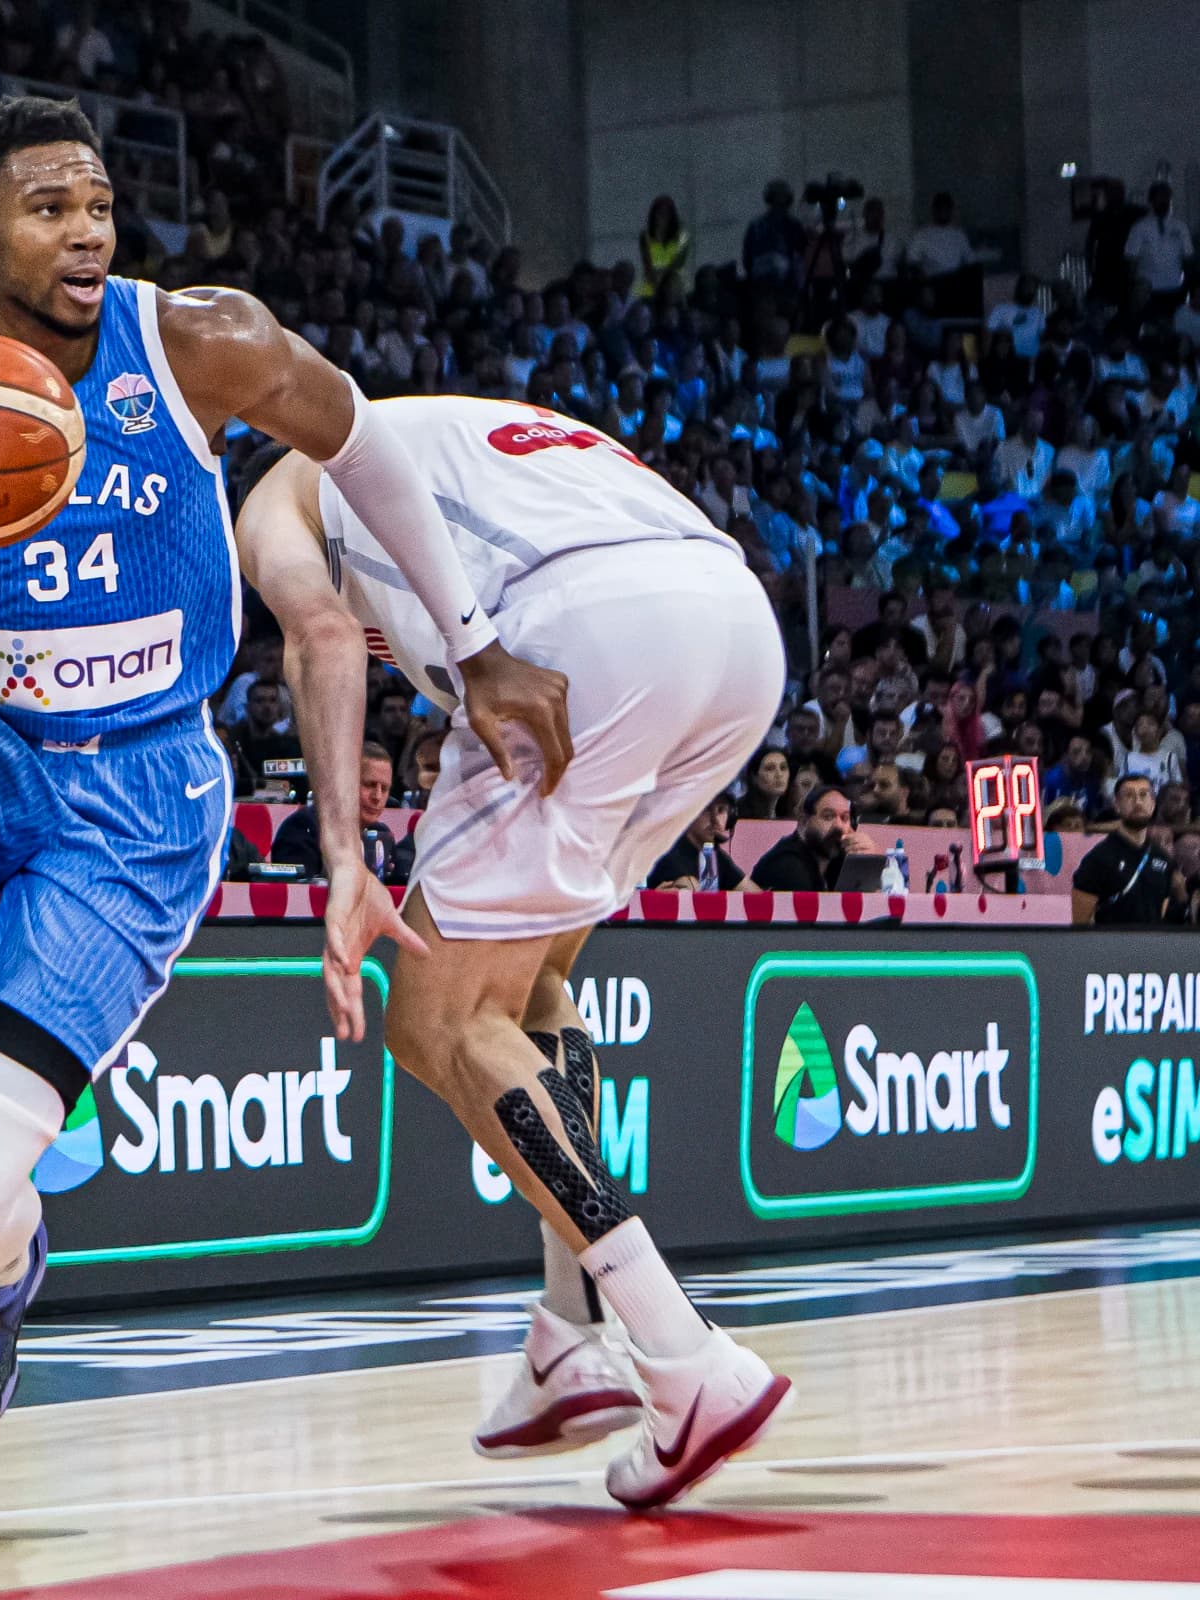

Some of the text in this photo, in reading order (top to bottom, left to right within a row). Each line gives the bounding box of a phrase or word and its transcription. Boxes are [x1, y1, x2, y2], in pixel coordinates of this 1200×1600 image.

[23, 533, 119, 602] 34
[562, 976, 652, 1046] AID
[1084, 973, 1200, 1035] PREPAI
[110, 1036, 352, 1175] Smart
[844, 1022, 1011, 1137] Smart
